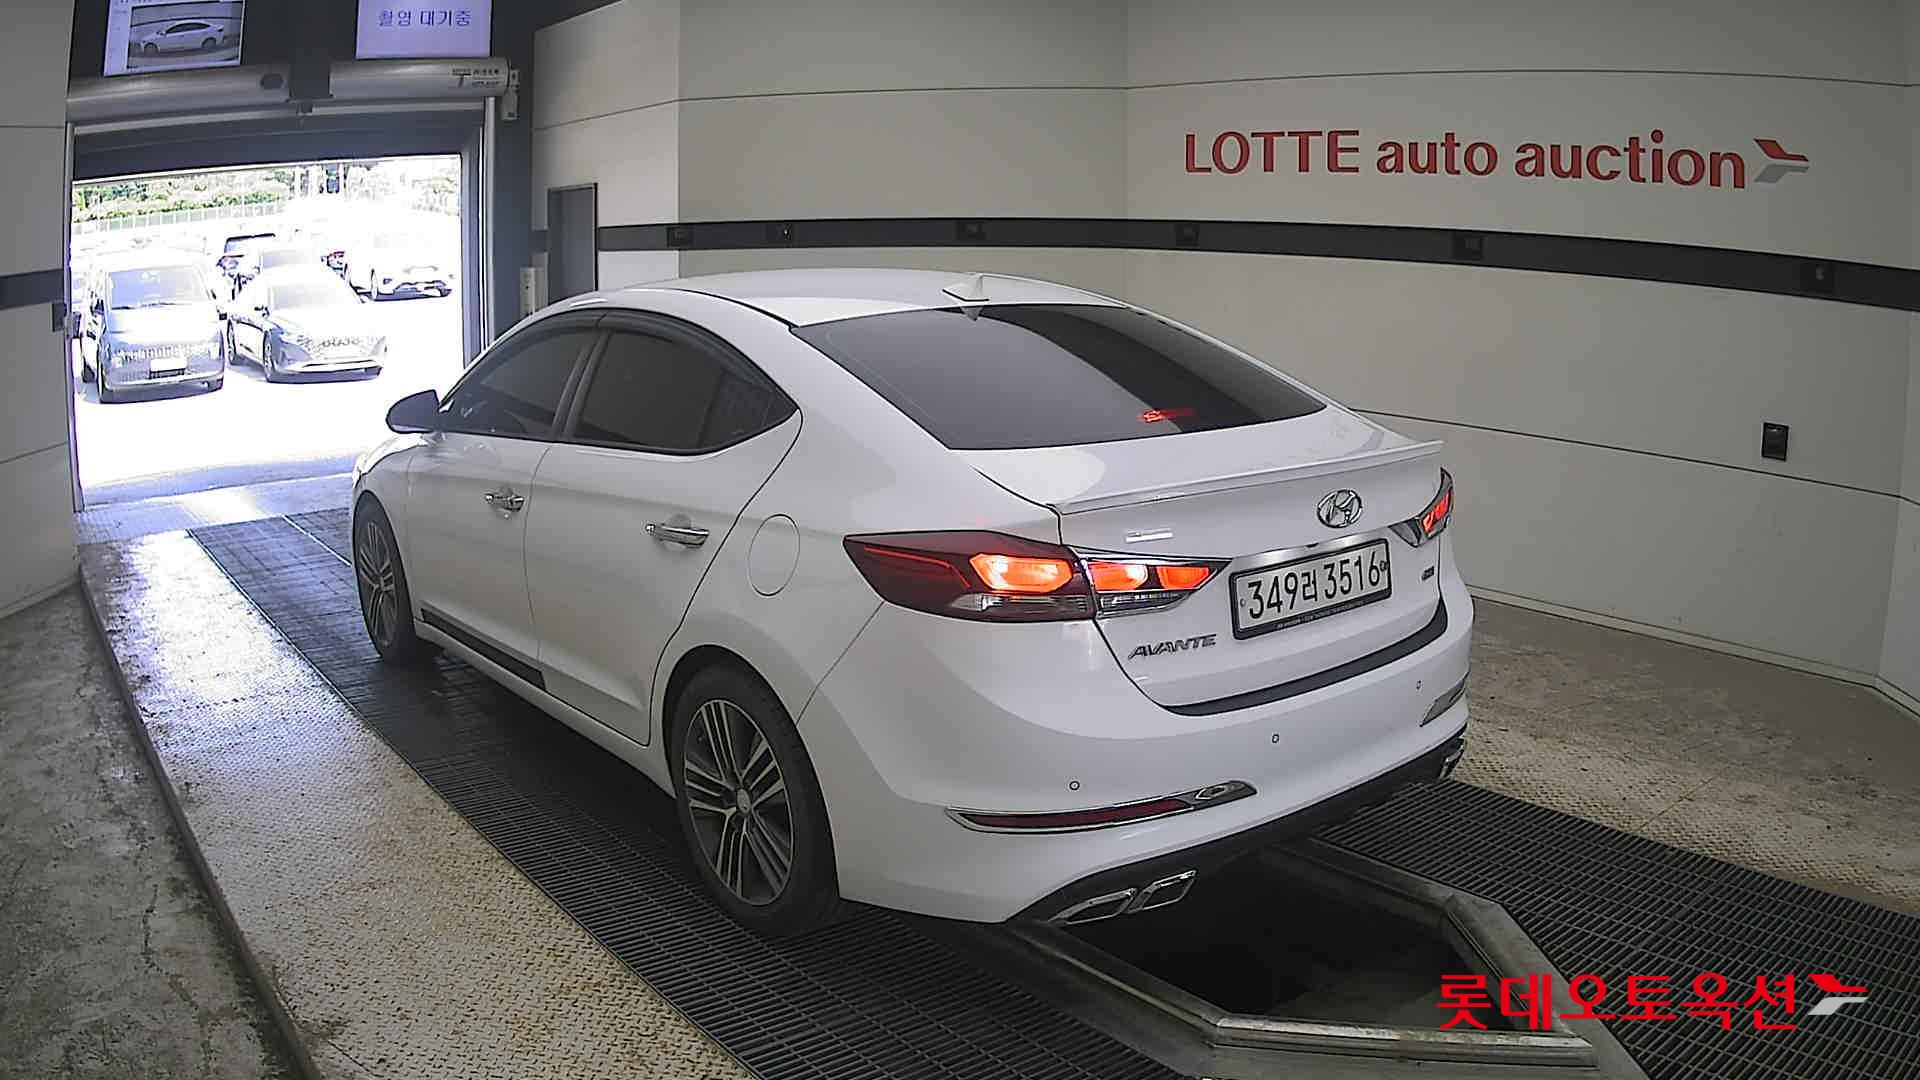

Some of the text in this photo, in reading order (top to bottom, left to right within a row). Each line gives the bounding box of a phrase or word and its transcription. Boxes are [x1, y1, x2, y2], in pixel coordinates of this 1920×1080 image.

[420, 10, 471, 26] 대기중
[1185, 129, 1745, 189] LOTTE auto auction
[1247, 569, 1318, 619] 349러
[1323, 551, 1380, 599] 3516
[1127, 633, 1217, 660] AVANTE
